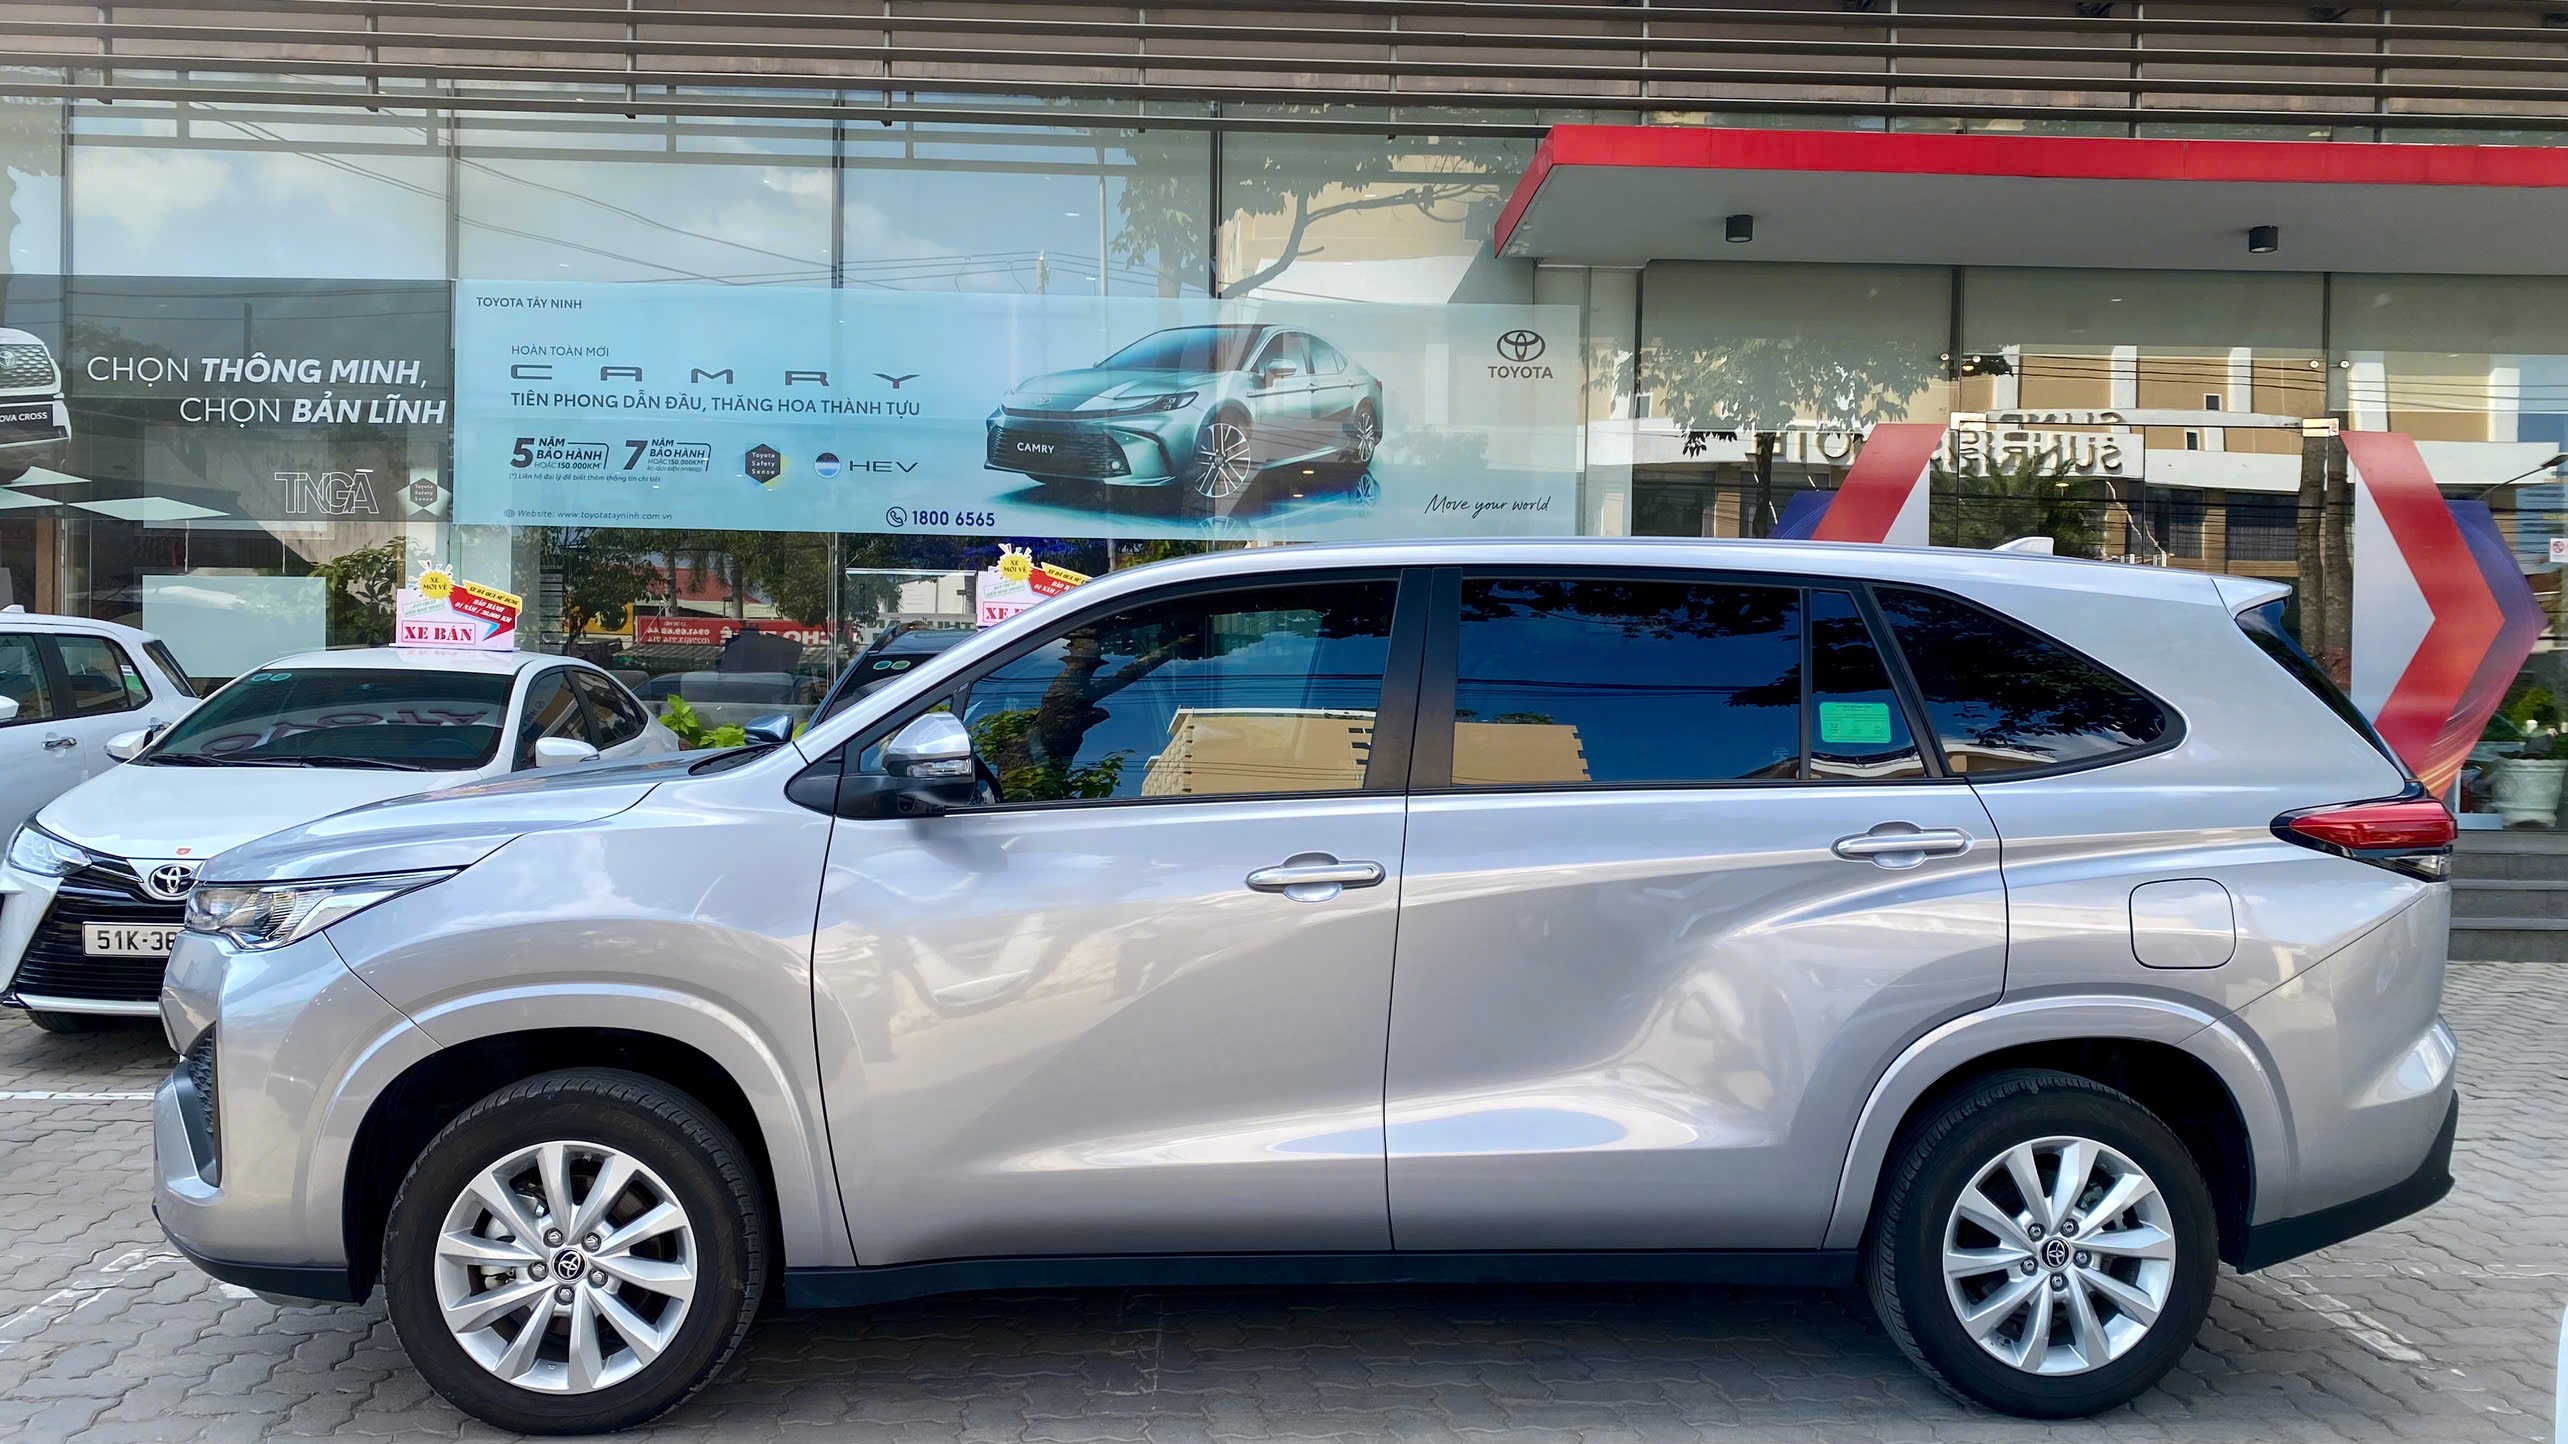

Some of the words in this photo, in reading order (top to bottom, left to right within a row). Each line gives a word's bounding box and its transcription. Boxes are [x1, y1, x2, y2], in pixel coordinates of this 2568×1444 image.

[476, 297, 523, 308] TOYOTA
[527, 296, 548, 309] TÂY
[551, 298, 582, 309] NINH
[511, 344, 547, 356] HOÀN
[550, 345, 583, 357] TOÀN
[586, 345, 609, 357] MỚI
[87, 357, 189, 388] CHỌN
[201, 352, 320, 383] THÔNG
[329, 360, 428, 389] MINH,
[511, 364, 920, 390] CAMRY
[1488, 366, 1553, 379] TOYOTA
[179, 397, 280, 428] CHỌN
[291, 391, 361, 424] BẢN
[368, 394, 446, 424] LĨNH
[511, 390, 549, 406] TIÊN
[553, 393, 618, 409] PHONG
[623, 389, 660, 409] DẪN
[665, 391, 707, 413] ĐẦU,
[711, 394, 773, 412] THĂNG
[778, 400, 816, 413] HOA
[821, 398, 881, 415] THÀNH
[886, 401, 920, 419] TỰU
[19, 412, 48, 421] CROSS
[539, 436, 565, 447] NĂM
[510, 438, 535, 468] 5
[536, 447, 563, 459] BẢO
[565, 448, 602, 460] HÀNH
[623, 440, 648, 470] 7
[649, 446, 672, 457] BẢO
[674, 448, 705, 458] HÀNH
[1016, 442, 1055, 455] CAMRY
[751, 452, 776, 460] Toyota
[849, 461, 919, 473] HEV
[1424, 494, 1469, 514] Move
[1473, 501, 1508, 519] your
[1512, 496, 1552, 512] world
[517, 509, 555, 518] Website:
[557, 511, 673, 521] www.toyotatayninh.com.vn
[912, 510, 949, 526] 1800
[955, 512, 995, 527] 6565
[986, 607, 1009, 620] XE
[404, 626, 428, 640] XE
[434, 625, 472, 641] BÁN
